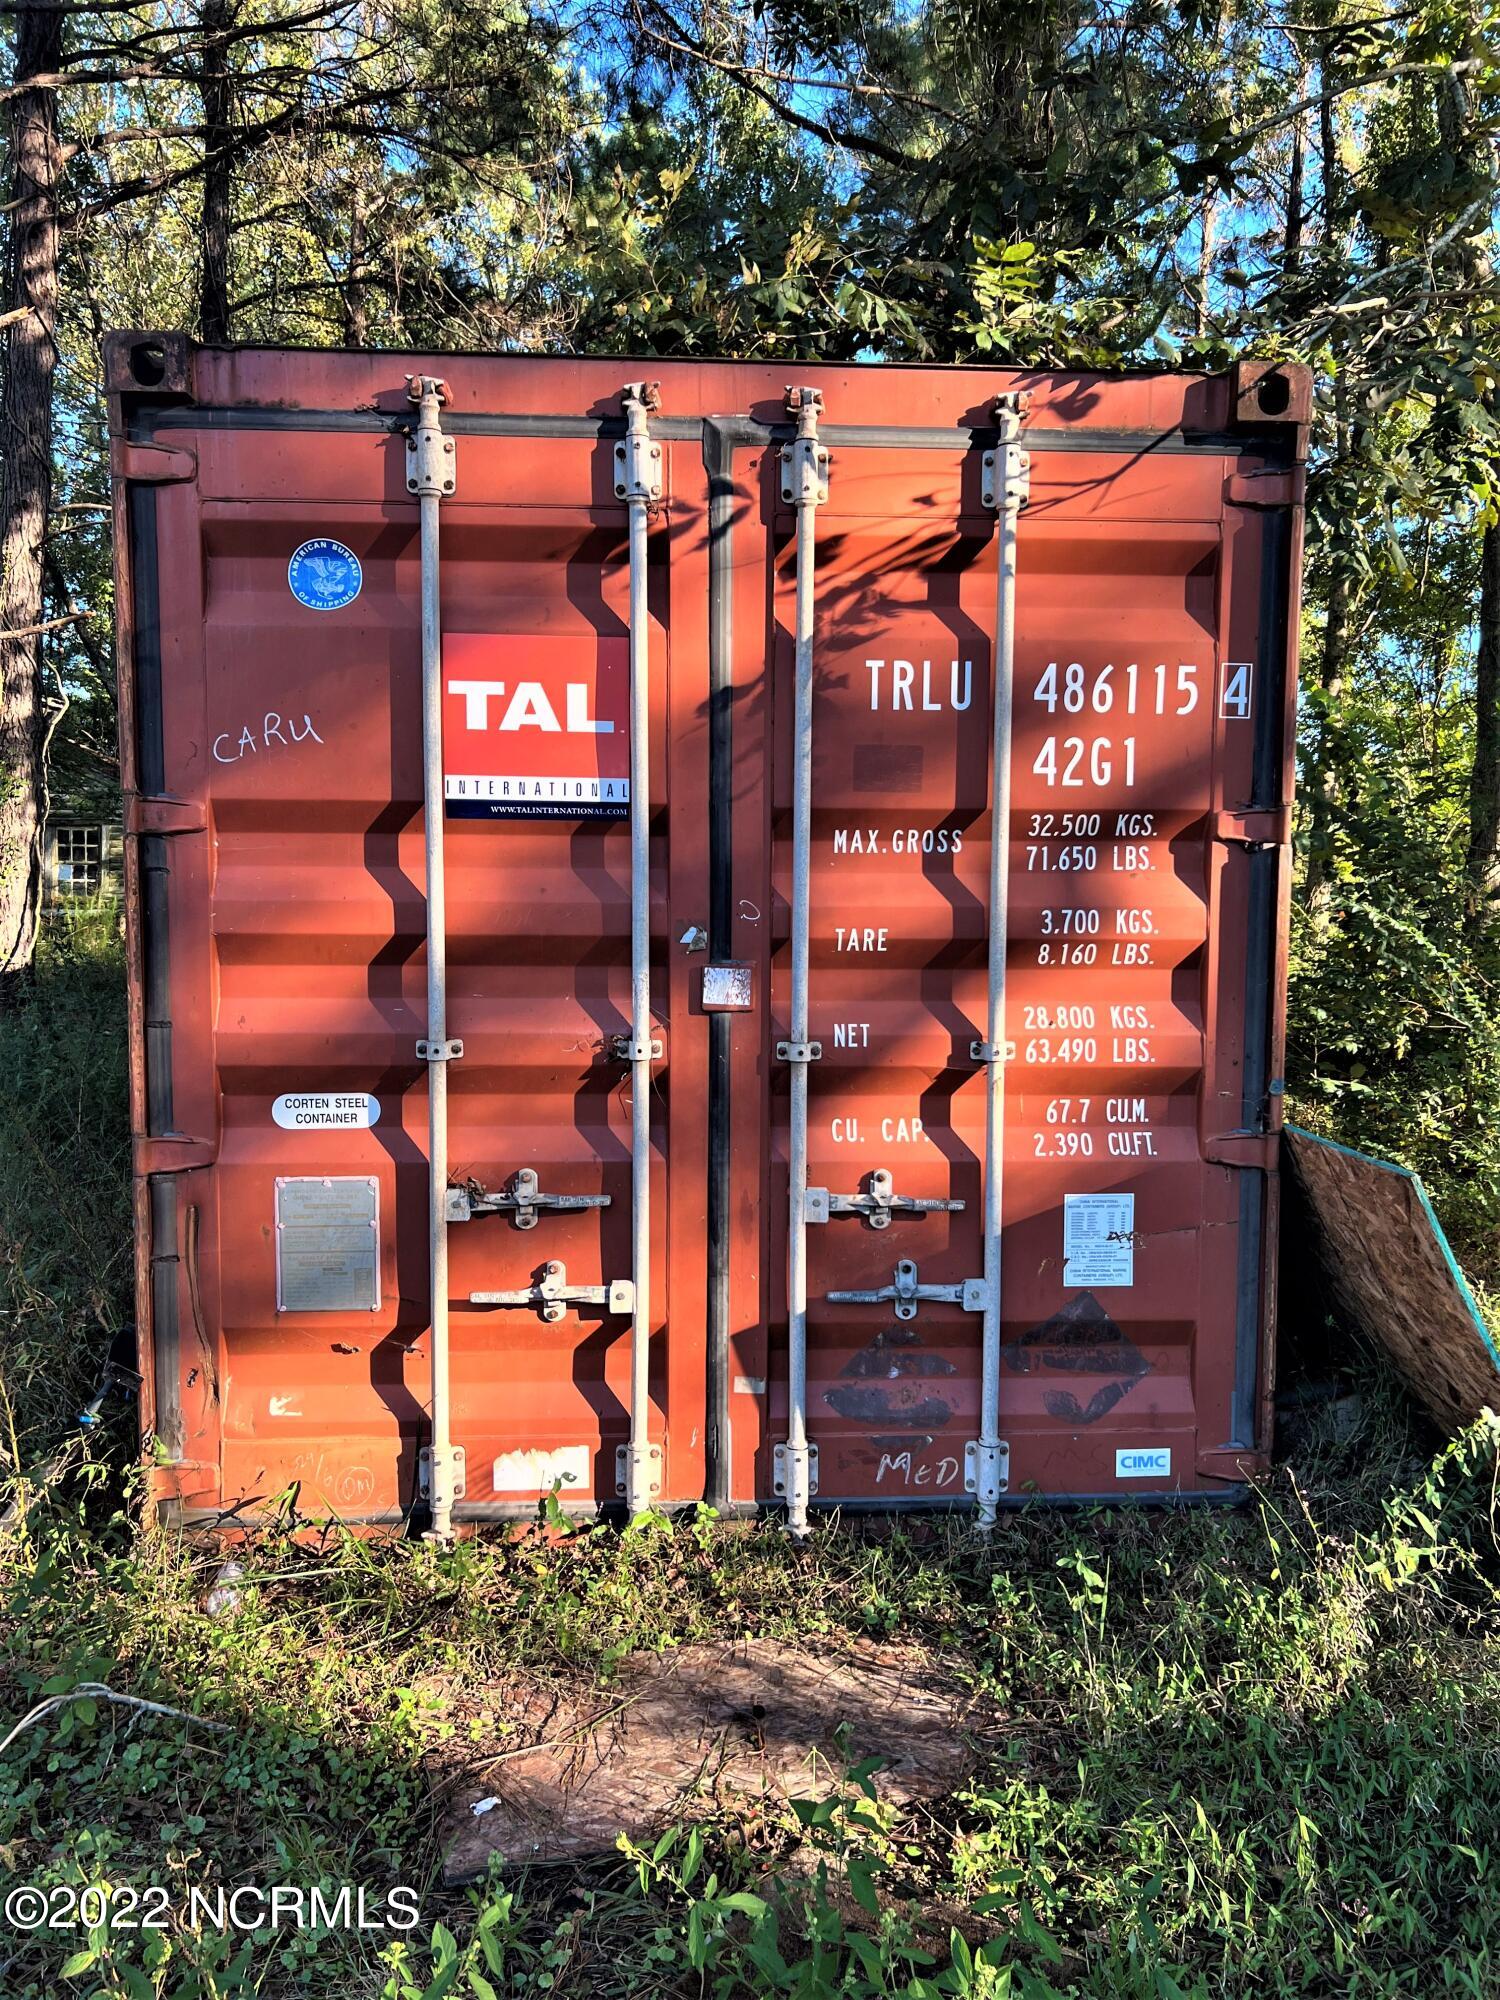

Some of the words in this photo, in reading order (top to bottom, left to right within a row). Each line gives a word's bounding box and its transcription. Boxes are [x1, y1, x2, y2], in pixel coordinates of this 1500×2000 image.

[291, 541, 327, 577] AMERICAN
[331, 543, 359, 577] BUREAU
[298, 591, 309, 601] OF
[310, 590, 355, 608] SHIPPING
[865, 659, 973, 711] TRLU
[1033, 662, 1199, 716] 486115
[1223, 665, 1248, 716] 4
[447, 679, 615, 734] TAL
[212, 712, 325, 763] CARU
[1032, 736, 1136, 787] 42G1
[446, 779, 628, 798] INTERNATIONAL
[490, 805, 628, 816] WWW.TALINTERNATIONAL.COM
[1115, 814, 1158, 836] KGS.
[1113, 845, 1157, 871] LBS.
[1116, 909, 1159, 935] KGS.
[835, 928, 888, 952] TARE
[1111, 943, 1154, 965] LBS.
[1109, 1006, 1155, 1029] KGS.
[833, 1023, 870, 1048] NET
[1112, 1038, 1156, 1063] LBS.
[284, 1098, 330, 1109] CORTEN
[334, 1097, 369, 1109] STEEL
[1046, 1099, 1091, 1124] 67.7
[295, 1112, 358, 1124] CONTAINER
[831, 1118, 865, 1142] CU.
[881, 1118, 929, 1142] CAP.
[1120, 1455, 1167, 1469] CIMC
